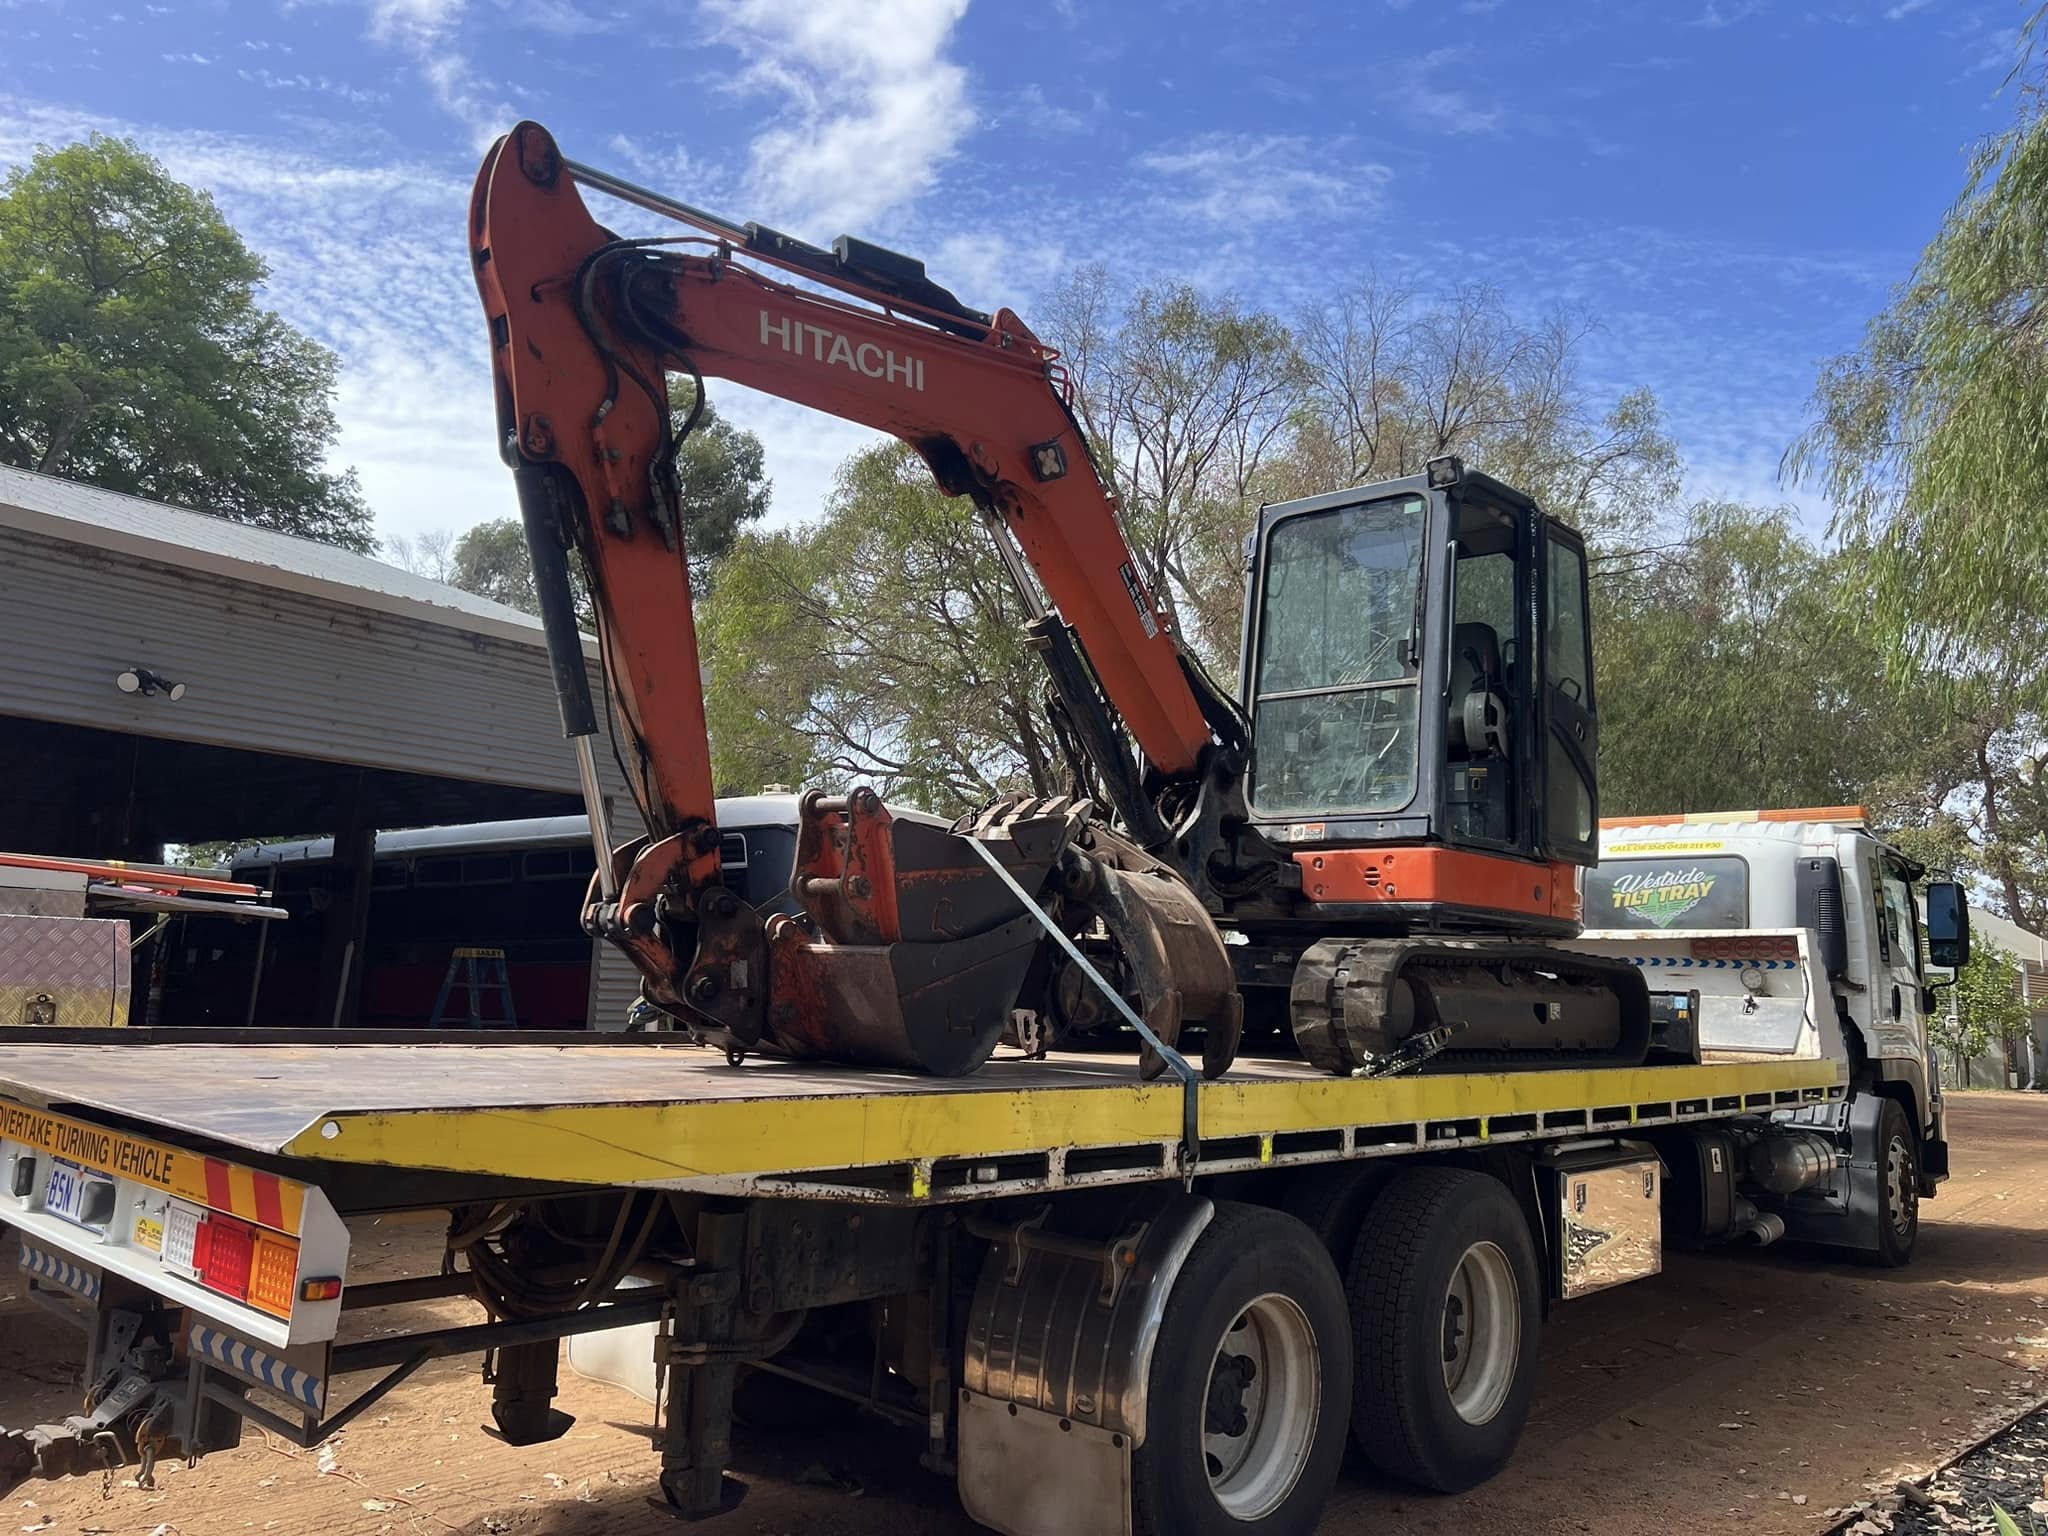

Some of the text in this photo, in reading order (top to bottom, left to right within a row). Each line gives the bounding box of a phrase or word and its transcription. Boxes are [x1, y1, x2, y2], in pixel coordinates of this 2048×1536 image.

[759, 309, 924, 392] HITACHI
[1612, 880, 1715, 909] TILT TRAY
[1613, 867, 1706, 894] Westside
[55, 1123, 110, 1165] TURNING
[113, 1137, 174, 1185] VEHICLE
